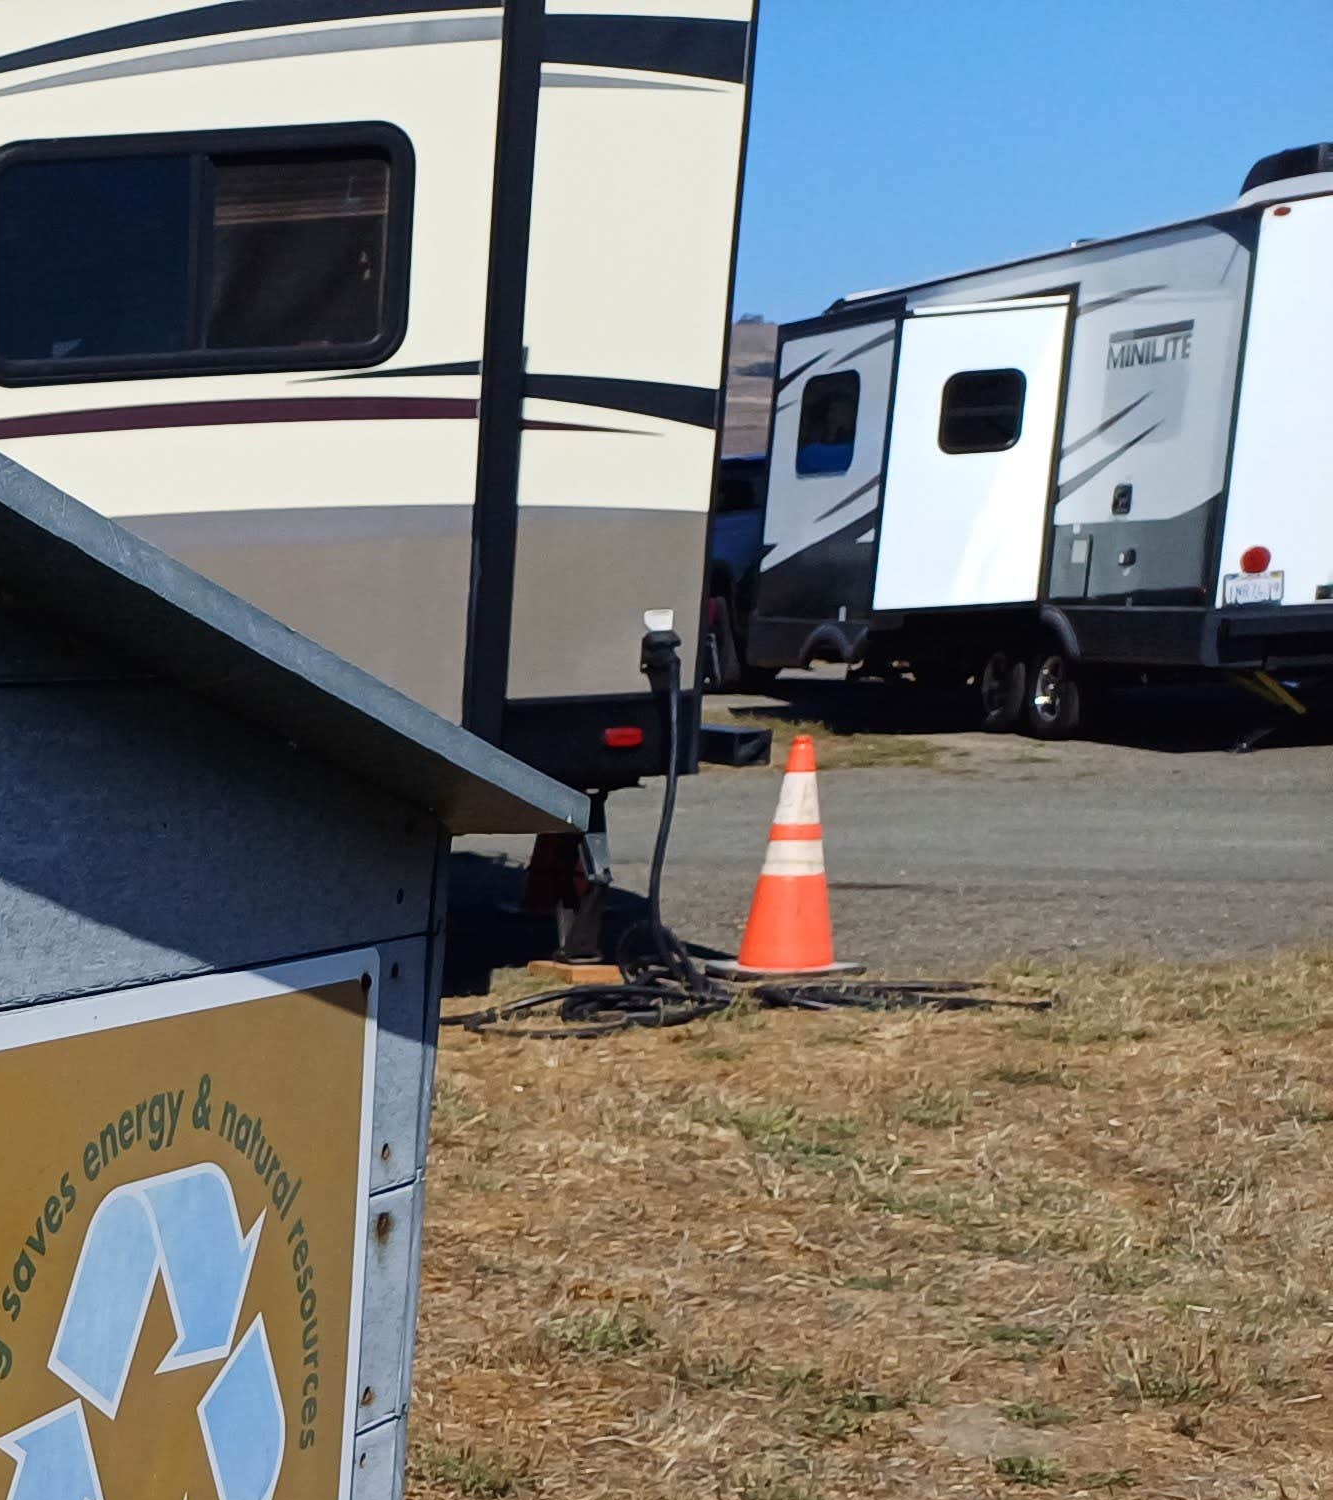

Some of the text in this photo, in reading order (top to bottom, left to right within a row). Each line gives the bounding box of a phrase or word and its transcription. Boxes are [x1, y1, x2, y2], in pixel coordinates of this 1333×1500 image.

[1107, 333, 1192, 370] MINILITE
[1, 1171, 76, 1322] saves
[82, 1089, 185, 1182] energy
[192, 1073, 212, 1131] &
[219, 1100, 303, 1221] natural
[287, 1216, 318, 1451] resources
